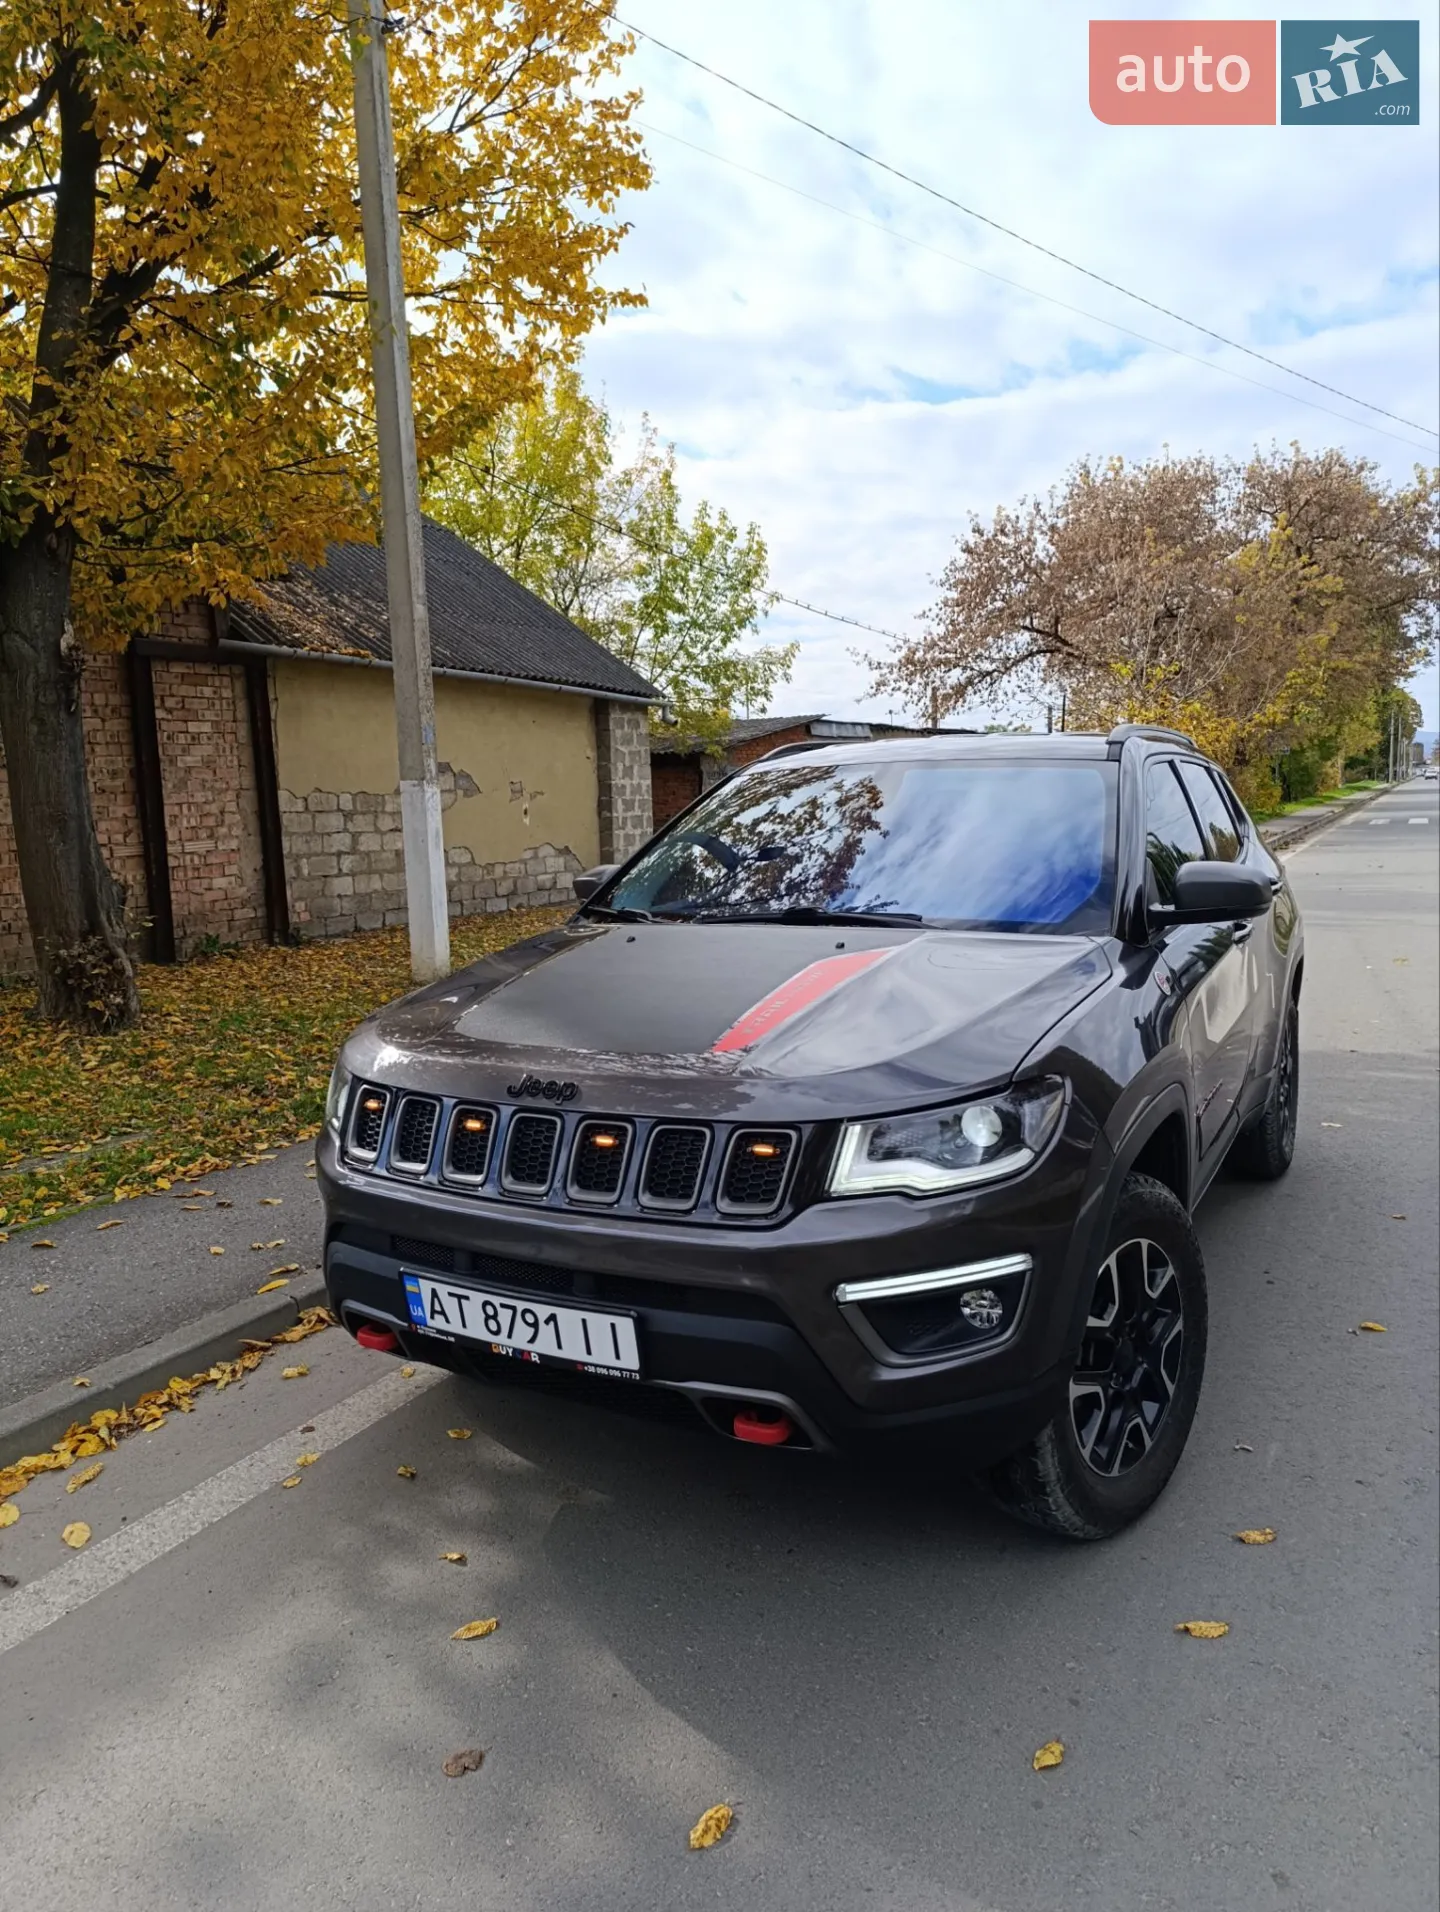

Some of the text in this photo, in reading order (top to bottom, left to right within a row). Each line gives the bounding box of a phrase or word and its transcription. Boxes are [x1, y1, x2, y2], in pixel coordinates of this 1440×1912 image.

[506, 1074, 579, 1106] Jeep
[409, 1304, 425, 1318] UA
[430, 1287, 471, 1330] AT
[482, 1300, 563, 1351] 8791
